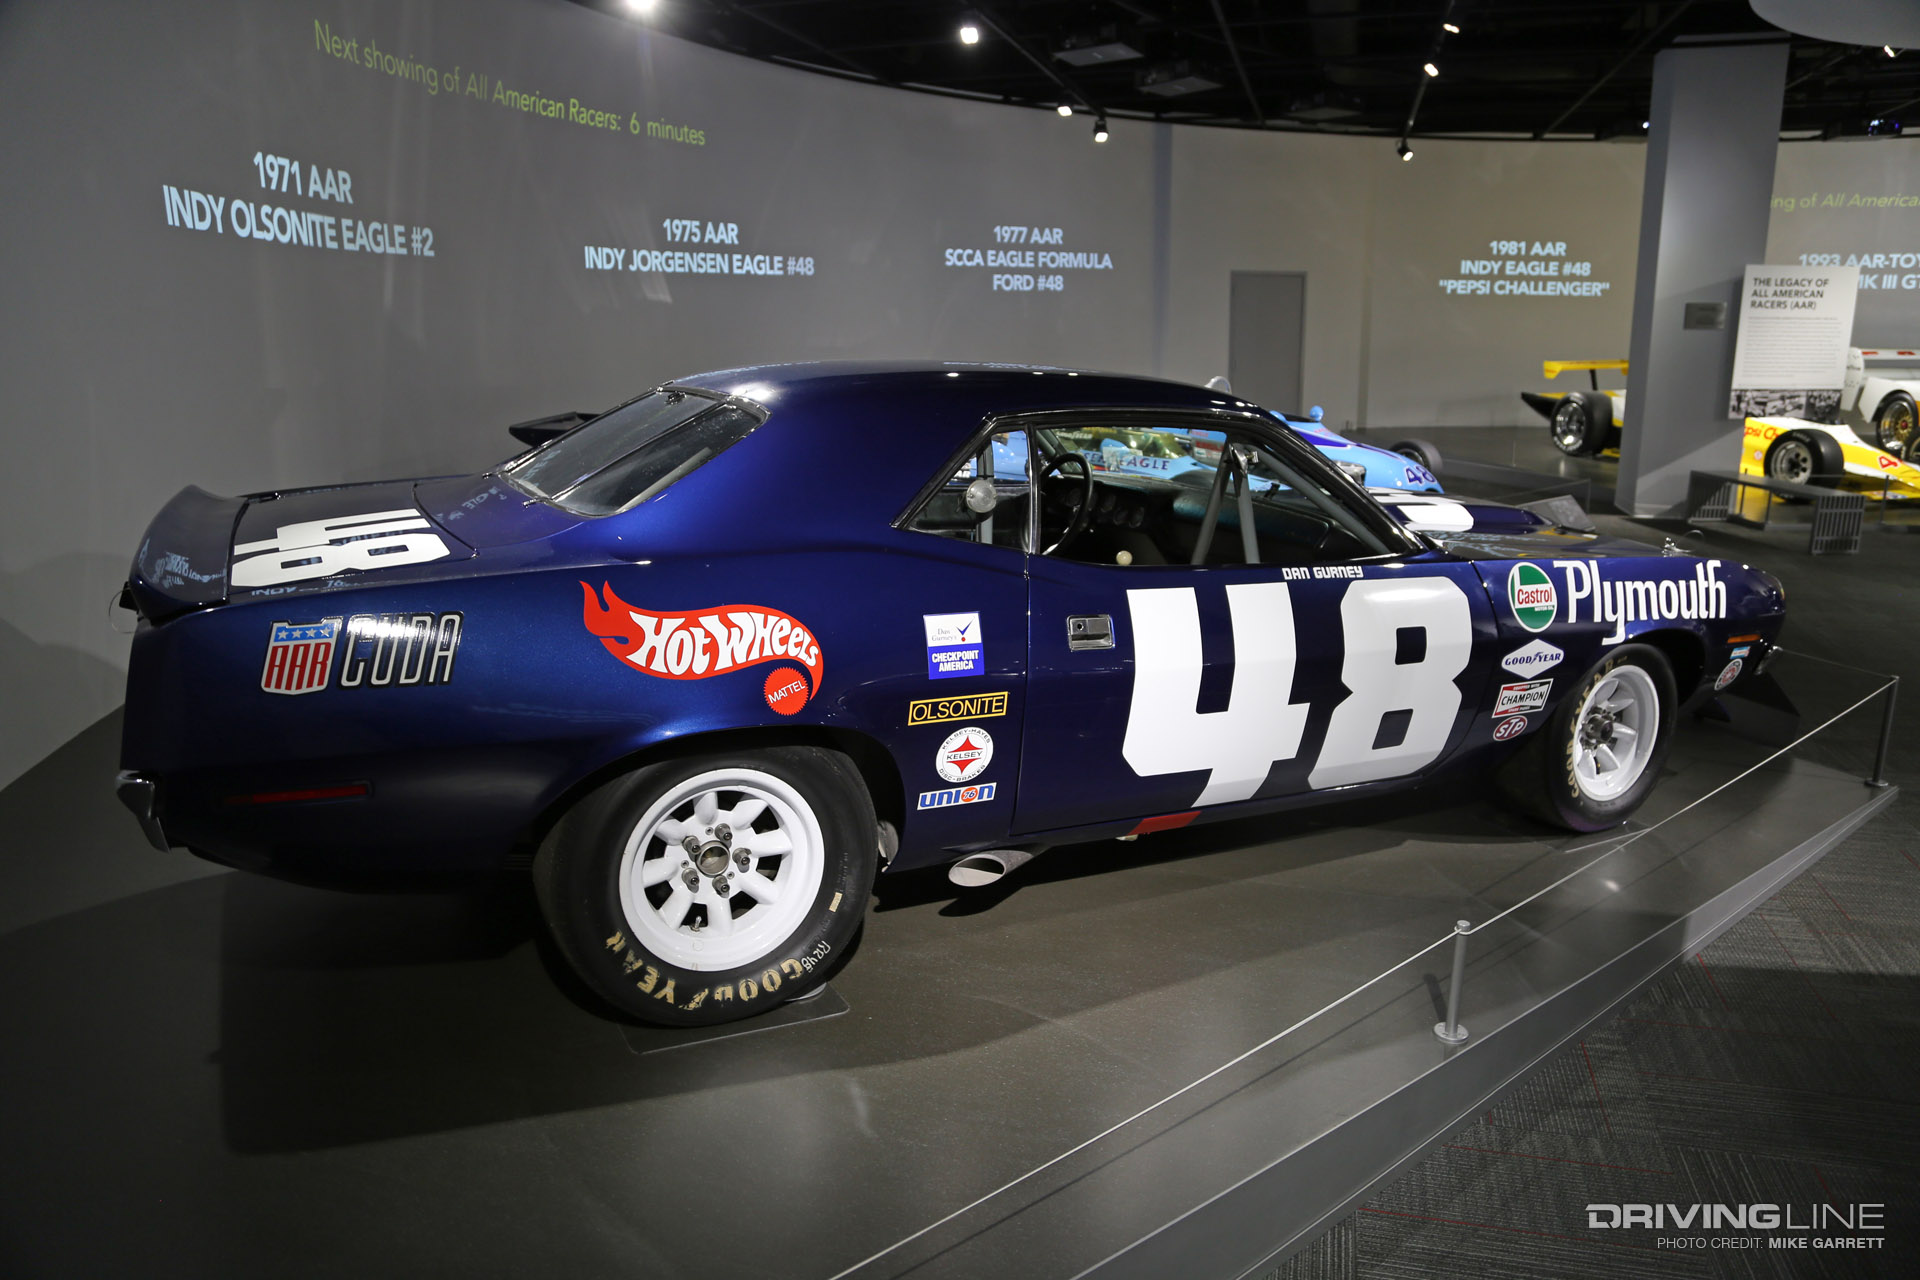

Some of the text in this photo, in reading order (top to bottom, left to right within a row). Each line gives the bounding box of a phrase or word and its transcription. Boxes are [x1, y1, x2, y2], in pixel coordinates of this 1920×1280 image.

[314, 19, 706, 145] Next showing of All American Racers: 6 minutes
[253, 151, 353, 204] 1971 AAR
[1800, 192, 1817, 209] of
[1820, 193, 1845, 208] All
[162, 184, 435, 257] INDY OLSONITE EAGLE #2
[662, 218, 739, 244] 1975 AAR
[993, 225, 1063, 244] 1977 AAR
[1489, 240, 1567, 256] 1981 AAR
[584, 246, 814, 276] INDY JORGENSEN EAGLE #48
[944, 248, 1113, 270] SCCA EAGLE FORMULA
[1460, 259, 1592, 277] INDY EAGLE #48
[992, 274, 1064, 292] FORD #48
[1438, 279, 1610, 297] "PEPSI CHALLENGER"
[1753, 277, 1829, 287] THE LEGACY OF
[1751, 289, 1824, 298] ALL AMERICAN
[1750, 300, 1816, 310] RACERS (AAR)
[1405, 465, 1437, 485] 48
[1282, 565, 1364, 580] DAN GURNEY
[1517, 587, 1553, 605] Castrol
[1552, 559, 1727, 646] Plymouth
[340, 614, 460, 687] CUDA
[931, 649, 979, 663] CHECKPOINT
[264, 642, 331, 691] AAR
[938, 660, 974, 672] AMERICA
[767, 679, 806, 704] MATTEL
[1122, 576, 1473, 808] 48
[1501, 691, 1545, 706] CHAMPION
[912, 696, 1004, 721] OLSONITE
[1496, 719, 1524, 737] STP
[946, 751, 983, 760] KELSEY
[963, 789, 976, 799] 76
